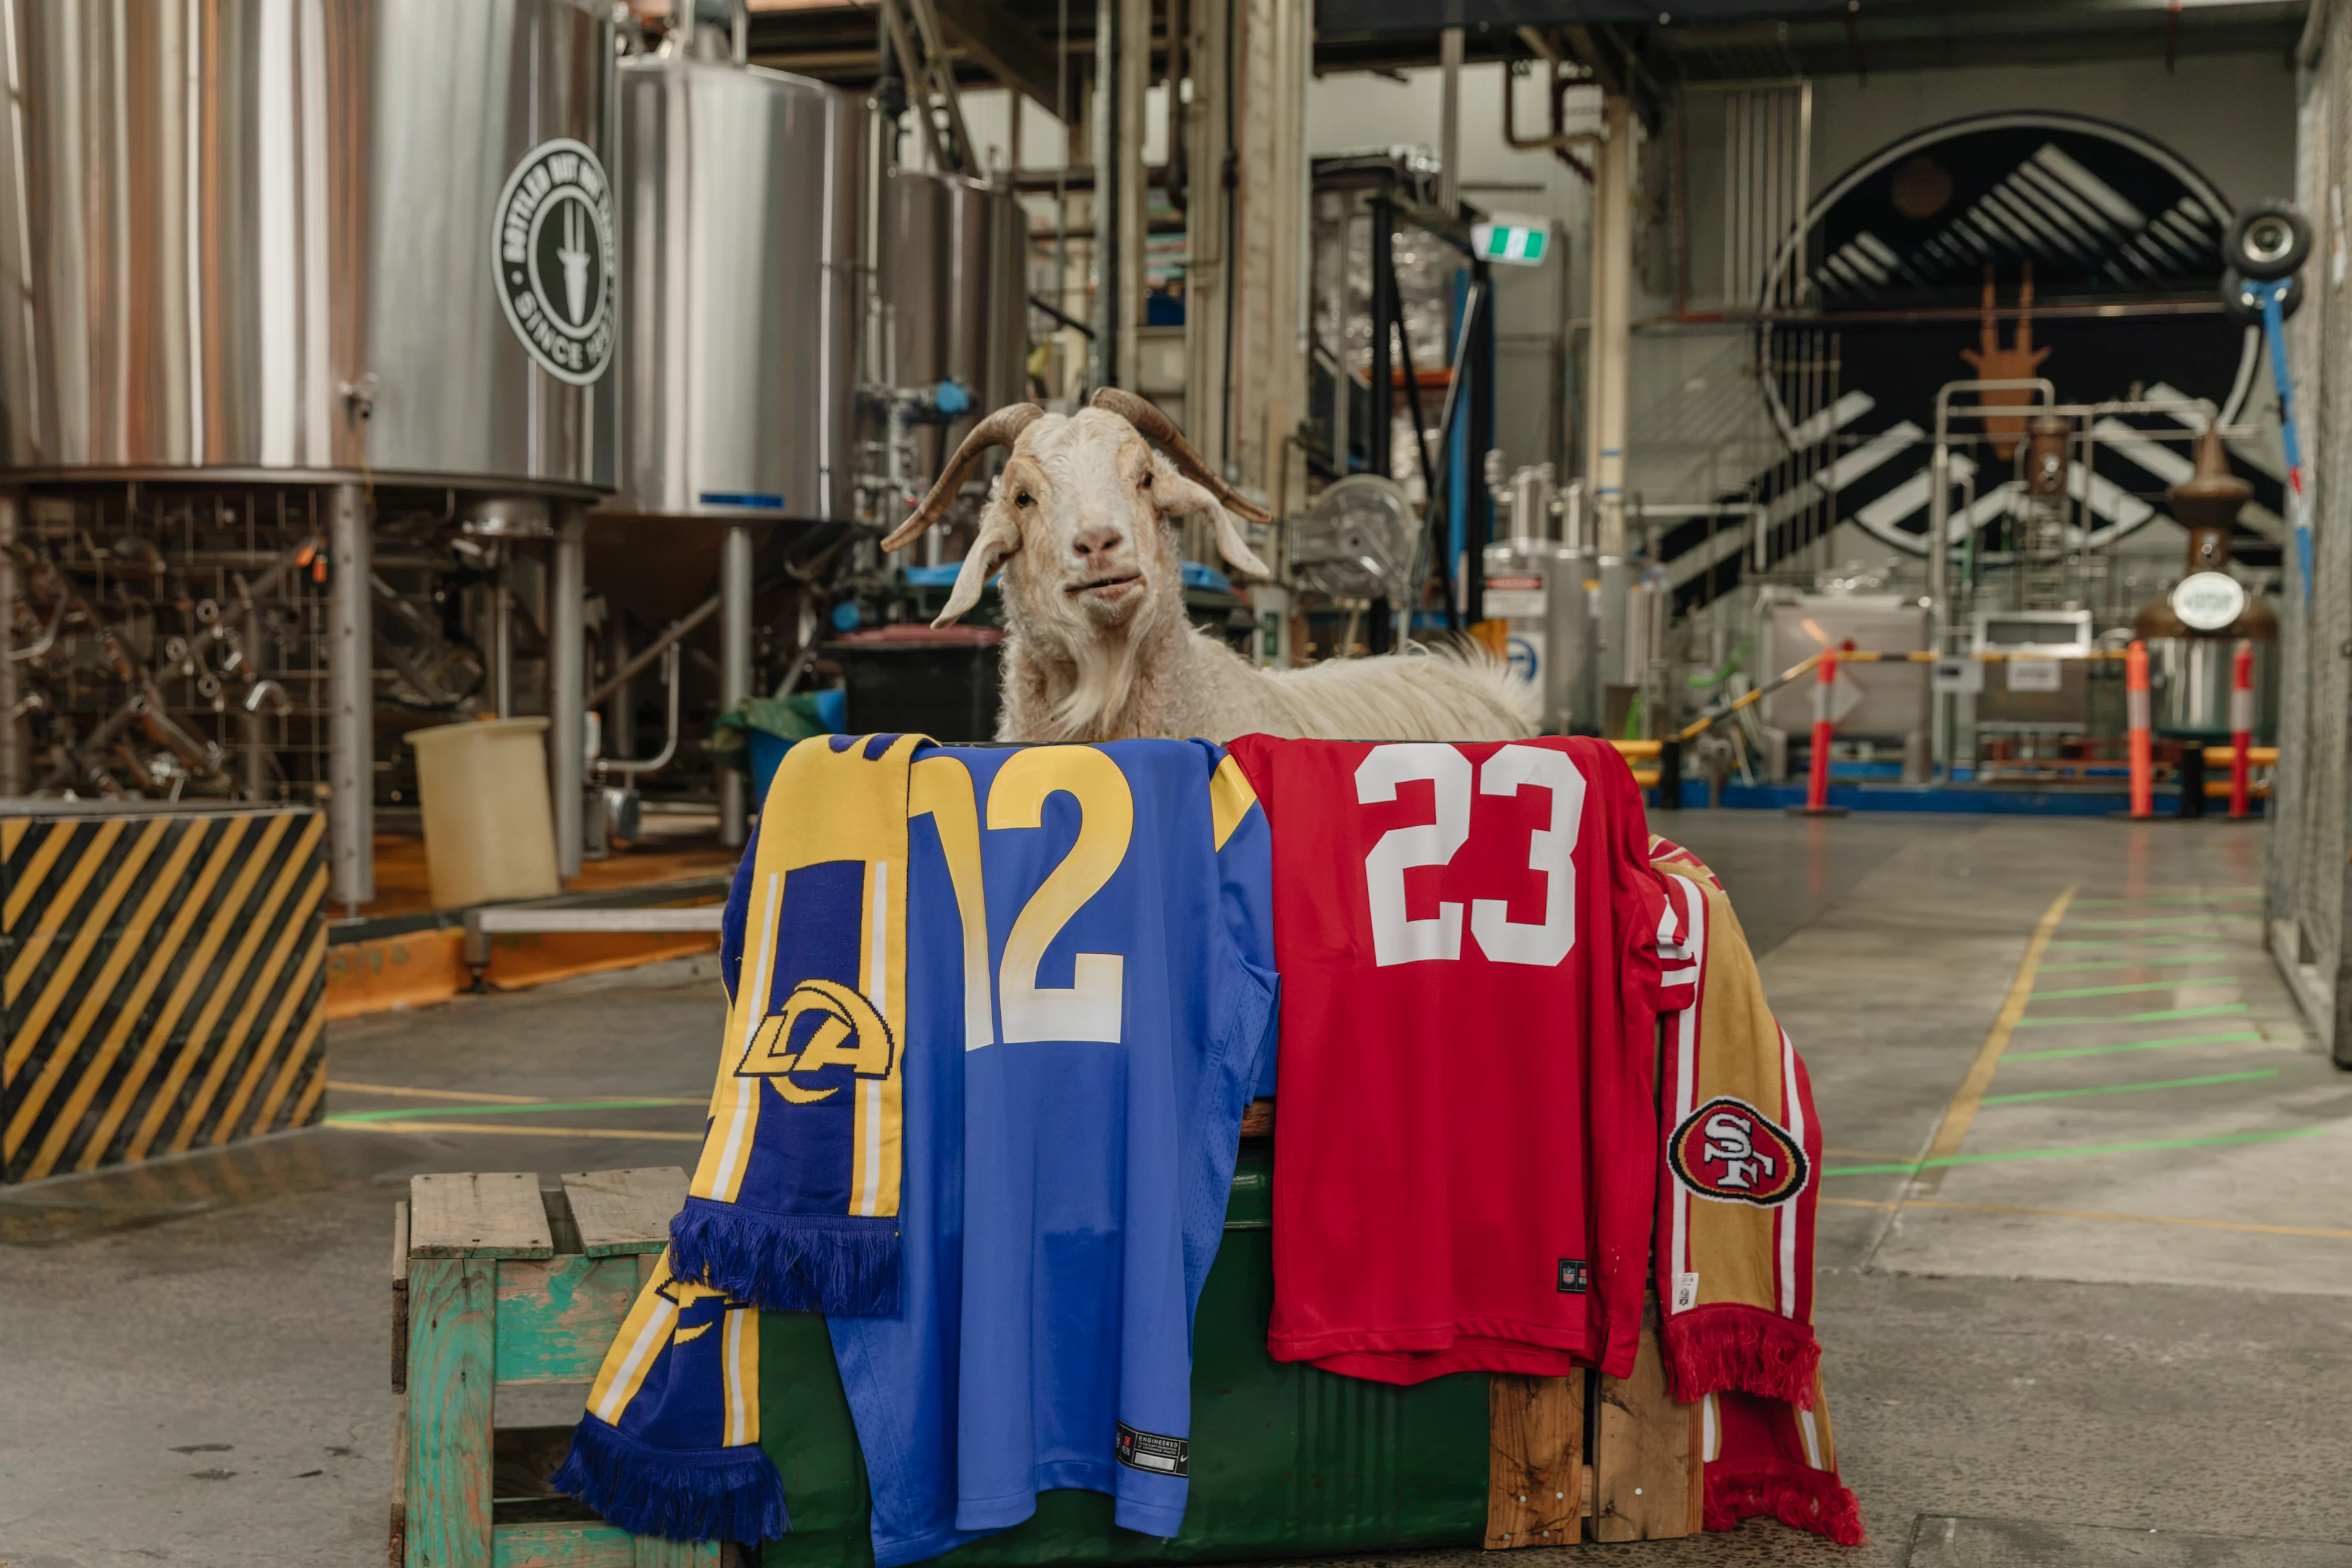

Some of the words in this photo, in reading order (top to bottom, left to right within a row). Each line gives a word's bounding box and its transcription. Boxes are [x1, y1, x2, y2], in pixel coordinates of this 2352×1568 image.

[503, 164, 552, 263] BOTTLED
[514, 294, 583, 371] SINCE
[908, 745, 1134, 1052] 12
[1354, 742, 1587, 967] 23
[1703, 1112, 1776, 1191] SF
[1138, 1436, 1178, 1448] ENGINEERED
